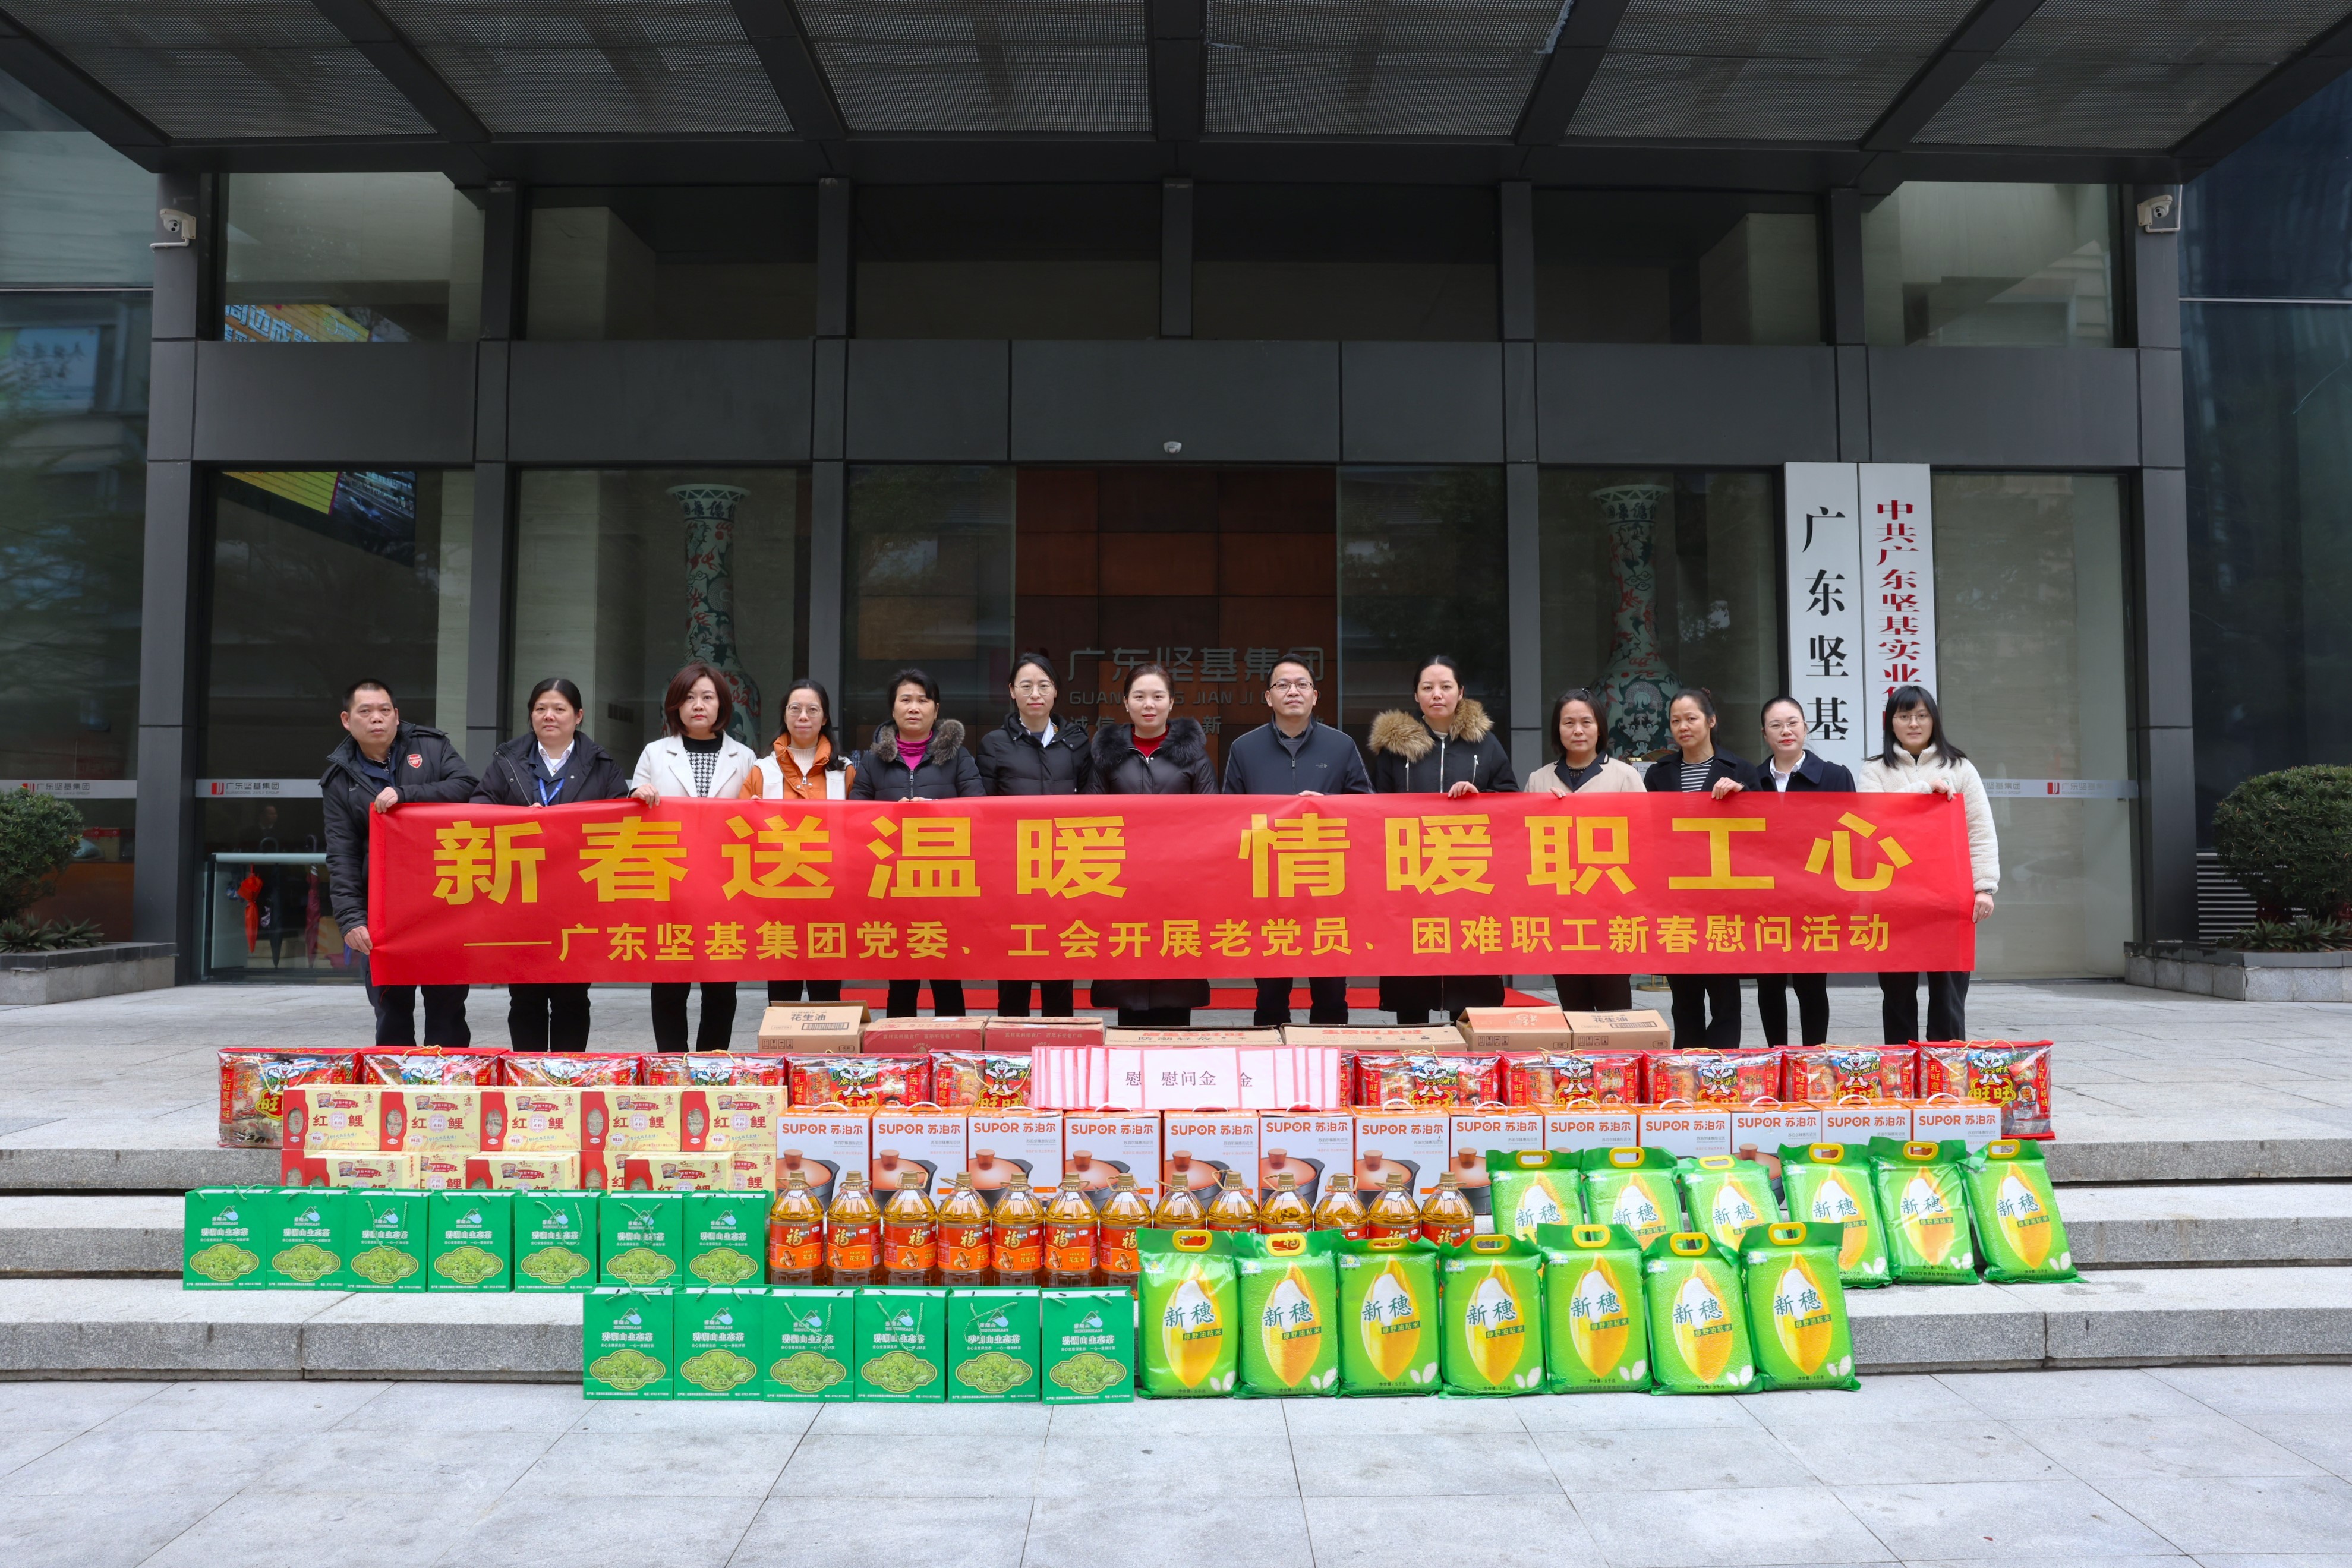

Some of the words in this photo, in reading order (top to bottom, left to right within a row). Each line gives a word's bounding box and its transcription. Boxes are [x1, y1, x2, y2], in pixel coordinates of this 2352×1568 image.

[1875, 500, 1922, 731] 中共广东坚基实业
[1802, 506, 1849, 740] 广东坚基
[1193, 692, 1232, 705] JIAN
[1240, 692, 1254, 705] JI
[226, 782, 279, 790] 广东坚基集团
[433, 815, 1128, 905] 新春送温暖
[1238, 812, 1913, 898] 情暖职工心
[791, 1014, 826, 1022] 花生油
[1125, 1071, 1142, 1086] 慰
[1161, 1070, 1216, 1087] 慰问金
[1973, 1086, 2012, 1101] 旺旺
[1456, 1122, 1502, 1132] SUPOR
[1505, 1121, 1538, 1131] 苏泊尔
[1646, 1121, 1690, 1132] SUPOR
[1694, 1120, 1726, 1131] 苏泊尔
[1738, 1118, 1782, 1128] SUPOR
[1785, 1116, 1817, 1127] 苏泊尔
[1827, 1117, 1871, 1128] SUPOR
[1874, 1116, 1906, 1126] 苏泊尔
[1919, 1115, 1962, 1126] SUPOR
[1965, 1115, 1995, 1125] 苏泊尔
[783, 1124, 827, 1134] SUPOR
[831, 1125, 863, 1135] 苏泊尔
[878, 1124, 924, 1134] SUPOR
[928, 1124, 960, 1134] 苏泊尔
[974, 1123, 1019, 1133] SUPOR
[1023, 1122, 1057, 1133] 苏泊尔
[1071, 1124, 1117, 1135] SUPOR
[1120, 1124, 1154, 1134] 苏泊尔
[1171, 1125, 1216, 1135] SUPOR
[1221, 1125, 1253, 1135] 苏泊尔
[1266, 1122, 1311, 1133] SUPOR
[1316, 1122, 1348, 1132] 苏泊尔
[1362, 1125, 1407, 1135] SUPOR
[1411, 1124, 1443, 1134] 苏泊尔
[1551, 1122, 1595, 1133] SUPOR
[1599, 1121, 1631, 1132] 苏泊尔
[1814, 1197, 1858, 1218] 新穗
[1900, 1195, 1944, 1215] 新穗
[1997, 1192, 2040, 1217] 新穗
[1516, 1203, 1560, 1228] 新穗
[1614, 1203, 1658, 1228] 新穗
[1712, 1202, 1757, 1226] 新穗
[201, 1228, 248, 1237] 碧湖山生态茶
[283, 1228, 331, 1237] 碧湖山生态茶
[445, 1231, 493, 1239] 碧湖山生态茶
[700, 1232, 747, 1241] 碧湖山生态茶
[1361, 1294, 1412, 1322] 新穗
[1571, 1291, 1620, 1318] 新穗
[1774, 1289, 1822, 1316] 新穗
[1164, 1301, 1214, 1328] 新穗
[1263, 1300, 1313, 1328] 新穗
[1466, 1299, 1516, 1326] 新穗
[1673, 1298, 1723, 1324] 新穗
[601, 1332, 653, 1342] 碧湖山生态茶
[692, 1332, 745, 1342] 碧湖山生态茶
[1062, 1335, 1115, 1345] 碧湖山生态茶
